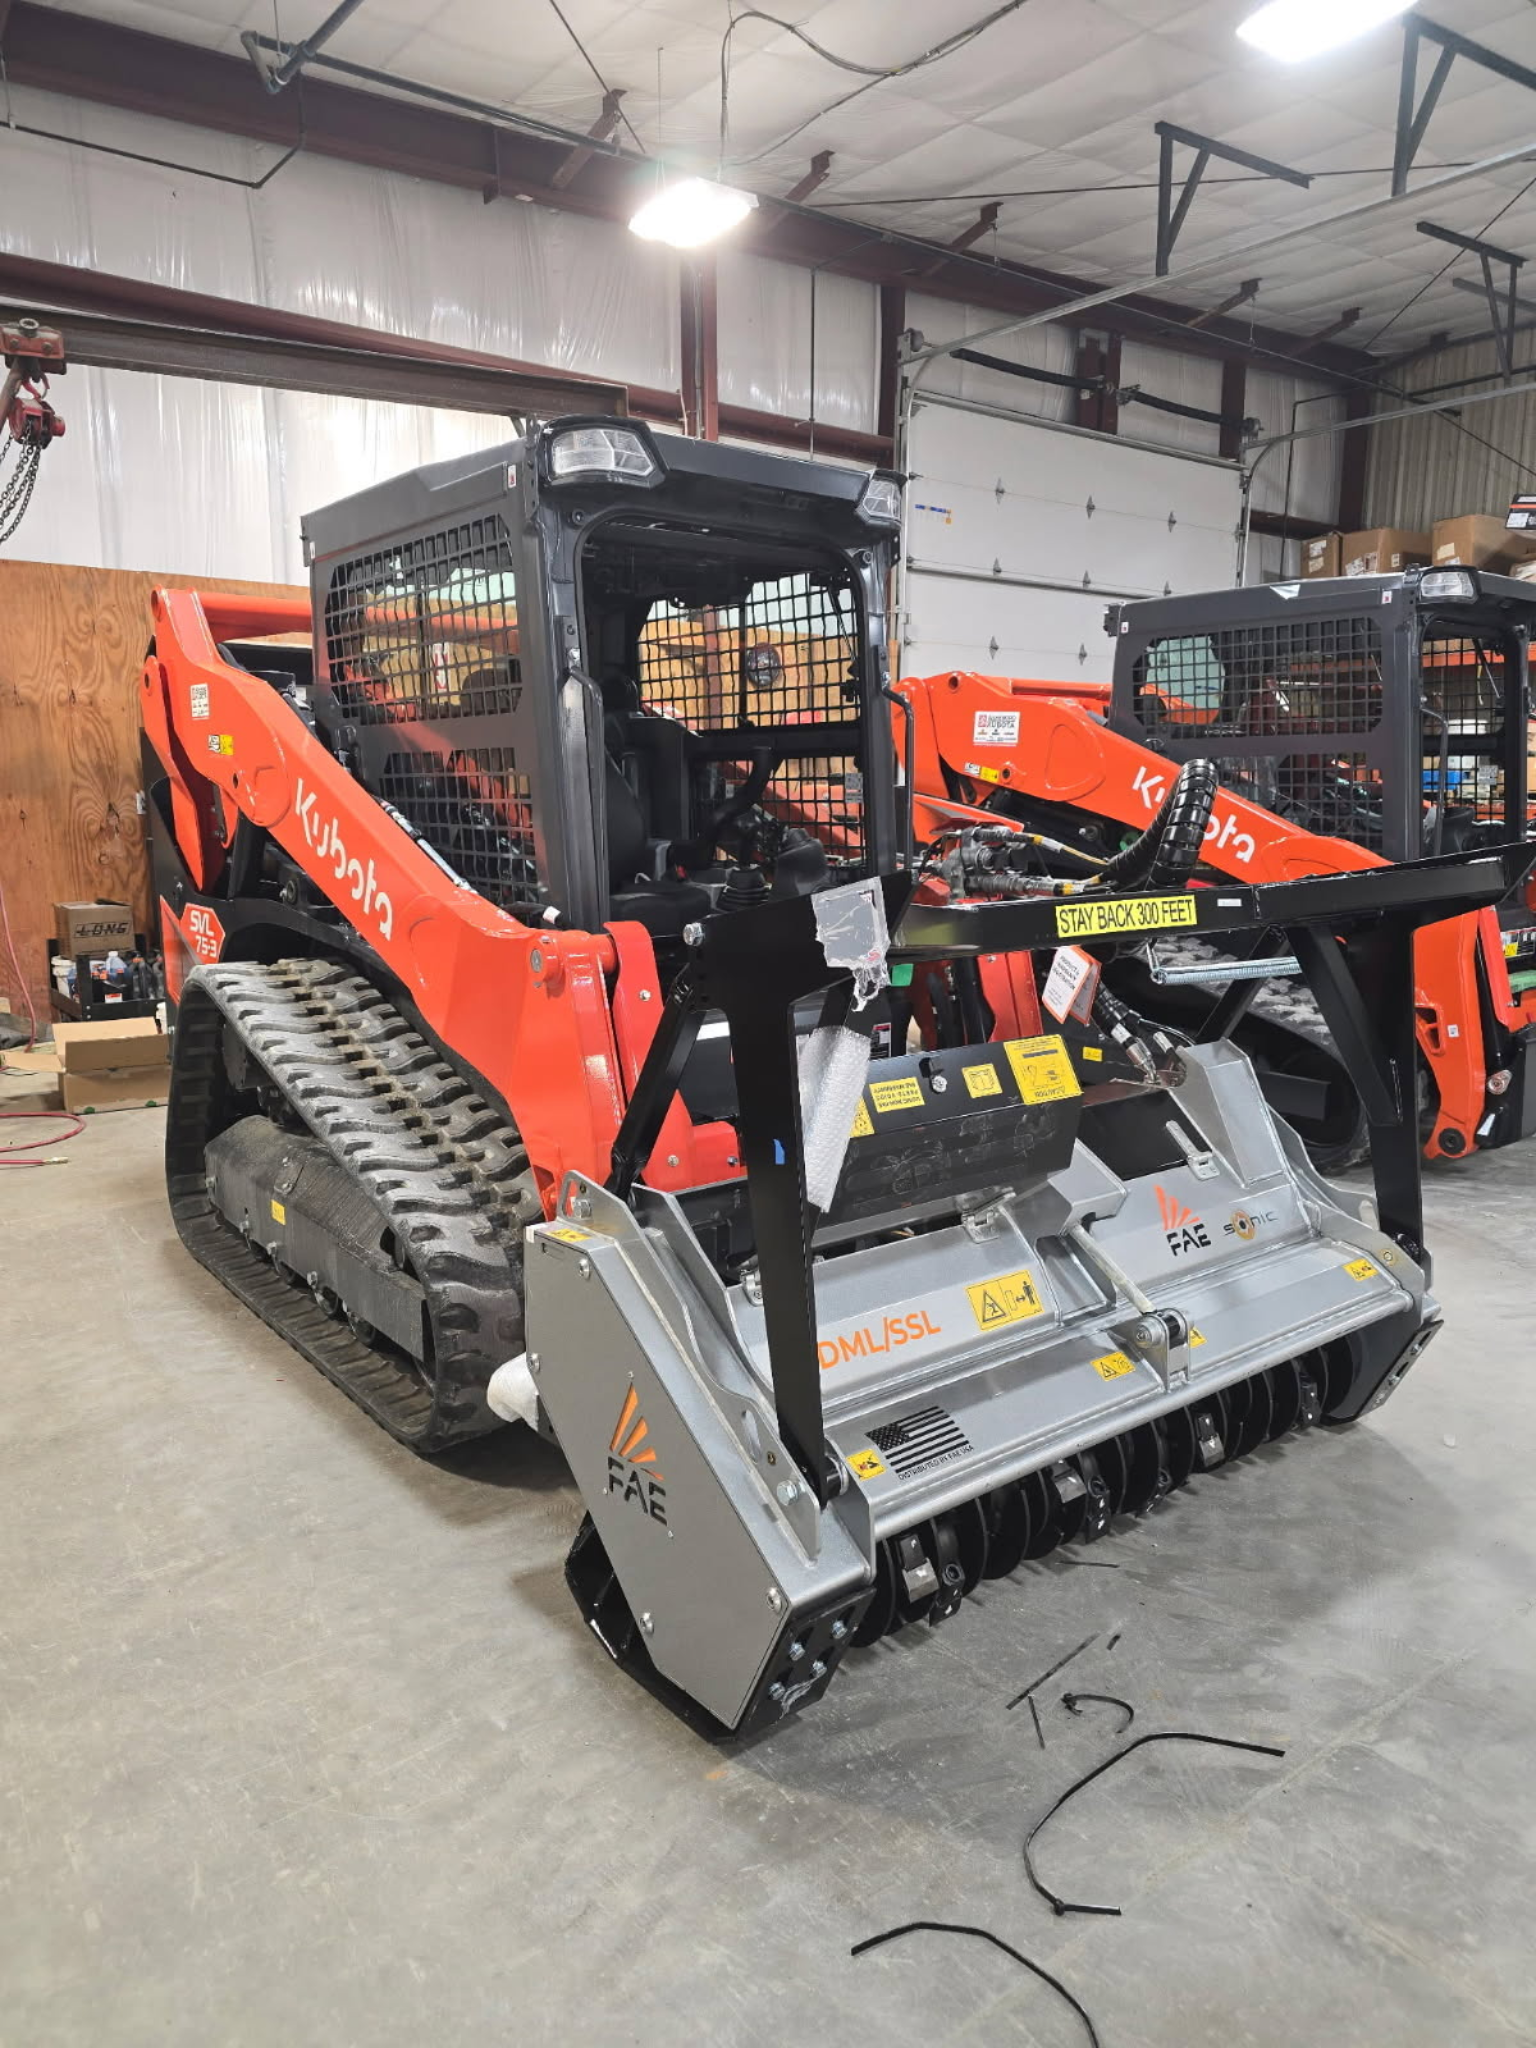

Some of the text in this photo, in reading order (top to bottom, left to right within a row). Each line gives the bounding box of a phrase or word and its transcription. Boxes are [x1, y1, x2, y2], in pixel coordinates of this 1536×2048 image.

[1132, 766, 1256, 863] Kota
[295, 777, 394, 942] Kubota
[75, 922, 129, 937] LONG
[189, 910, 215, 937] SVL
[1059, 899, 1193, 933] STAY BACK 300 FEET
[195, 936, 218, 958] 75-3
[1166, 1223, 1212, 1257] FAE
[817, 1310, 942, 1370] DML/SSL
[607, 1456, 668, 1527] FAE
